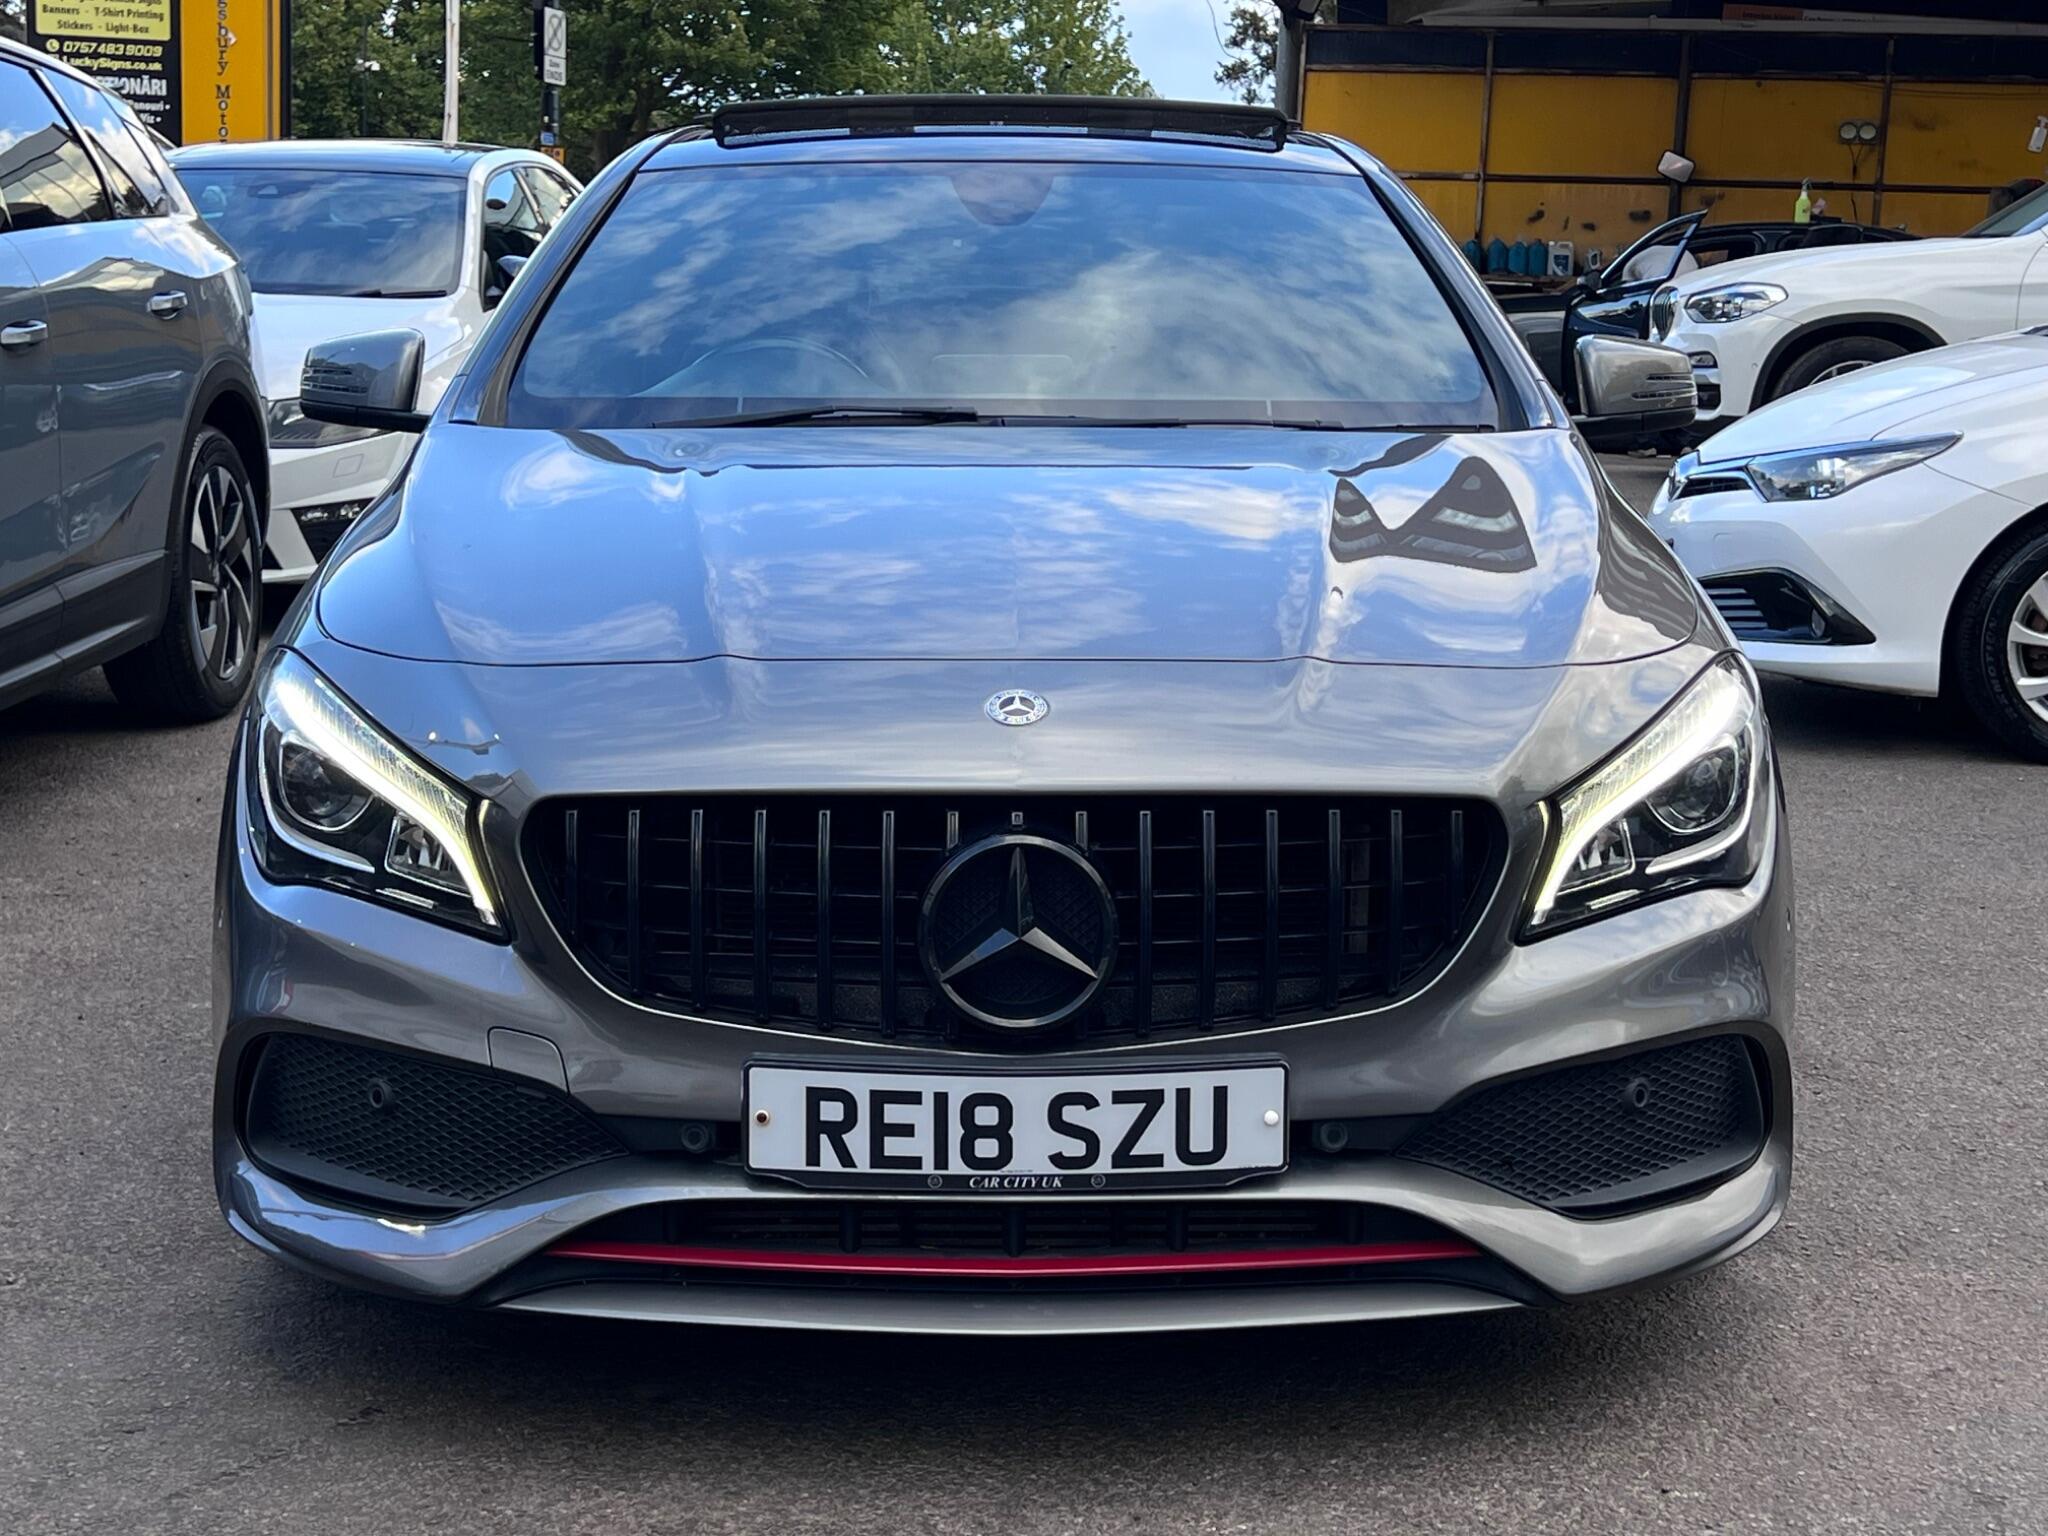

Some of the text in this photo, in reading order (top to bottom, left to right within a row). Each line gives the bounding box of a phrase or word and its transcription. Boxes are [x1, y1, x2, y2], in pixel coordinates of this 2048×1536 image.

[42, 4, 164, 22] Banners T-Shirt Printing
[57, 20, 93, 30] Stickers
[62, 41, 98, 53] 0757
[216, 85, 231, 143] Moto
[805, 1085, 1229, 1170] RE18 SZU
[969, 1176, 1063, 1188] CAR CITY UK
